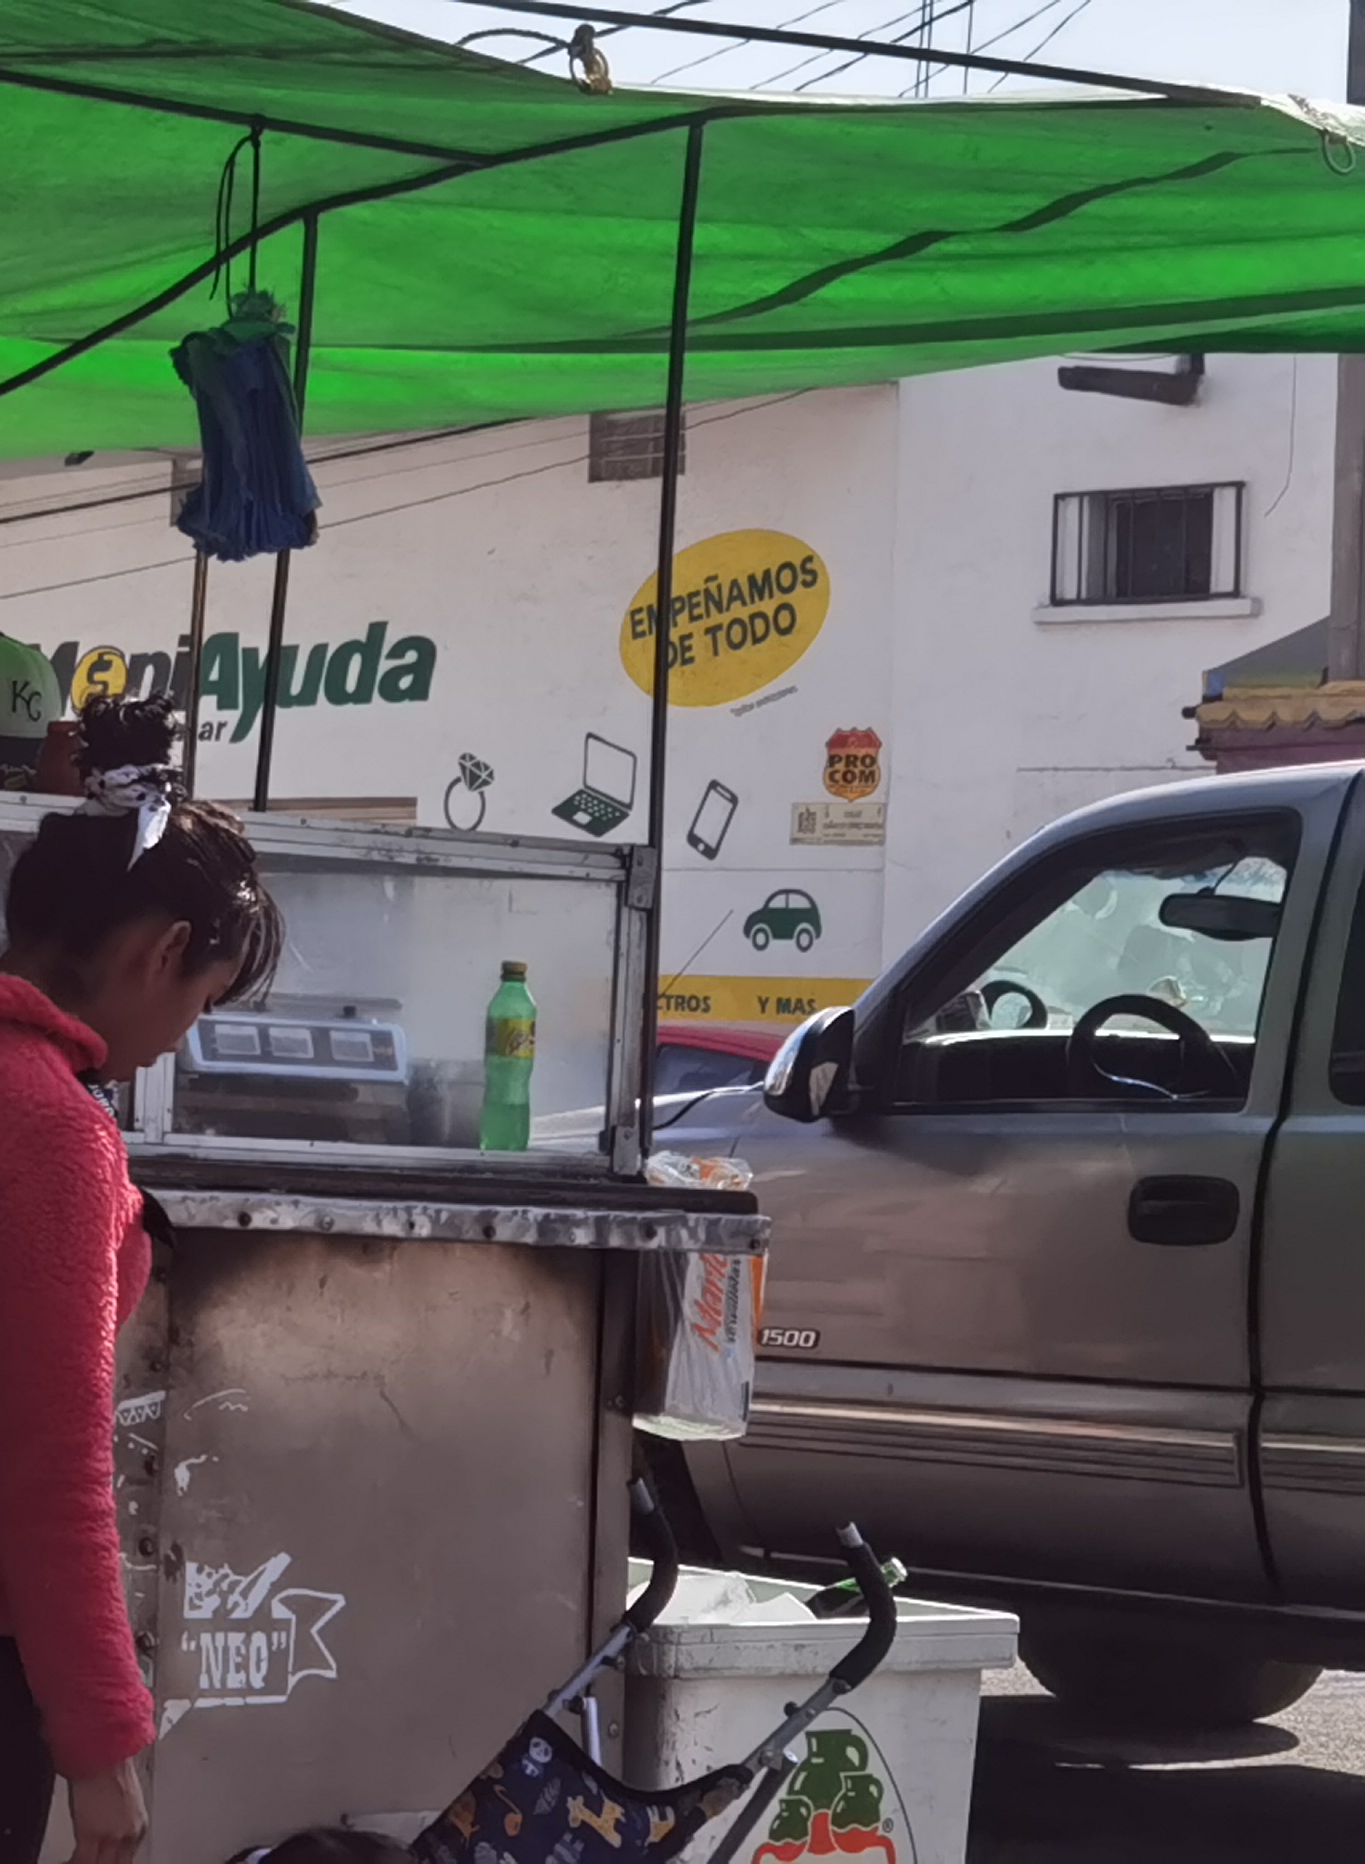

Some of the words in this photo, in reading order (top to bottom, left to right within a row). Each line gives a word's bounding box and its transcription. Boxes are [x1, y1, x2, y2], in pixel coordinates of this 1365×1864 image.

[704, 602, 797, 657] TODO
[11, 679, 43, 722] KC
[828, 753, 877, 769] PRO
[828, 769, 877, 785] COM
[757, 996, 770, 1015] Y
[775, 997, 817, 1016] MAS
[760, 1329, 816, 1348] 1500
